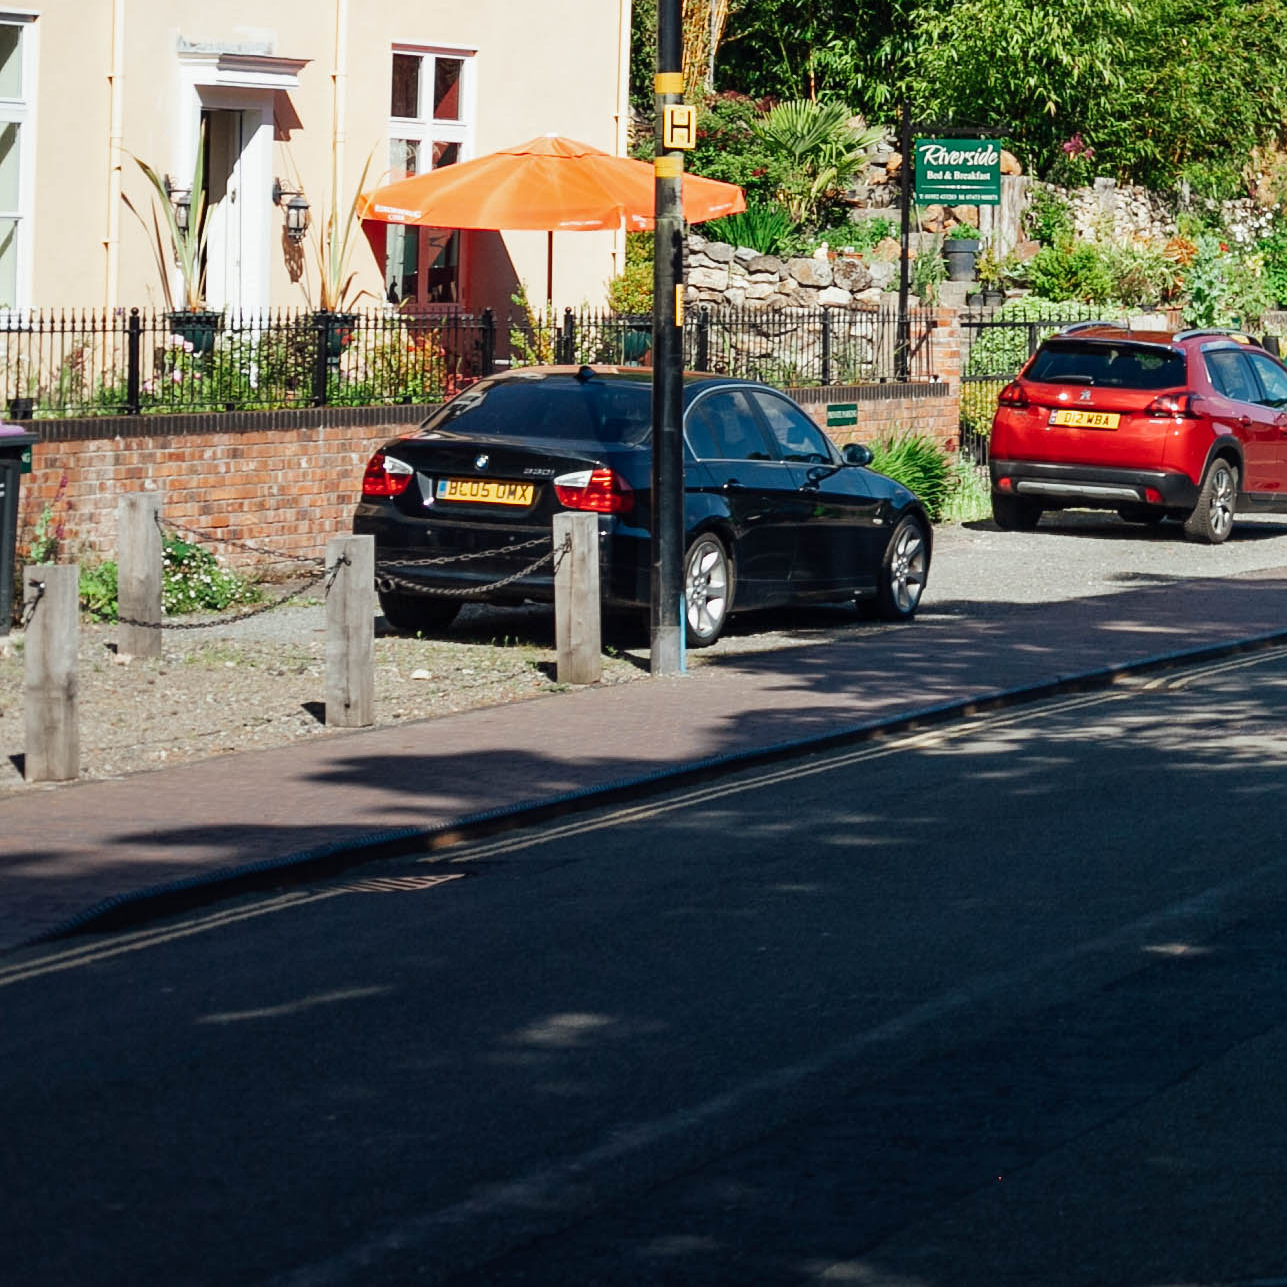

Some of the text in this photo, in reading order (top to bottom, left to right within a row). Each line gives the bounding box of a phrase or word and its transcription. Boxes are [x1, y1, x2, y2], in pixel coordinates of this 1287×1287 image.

[671, 109, 691, 144] H
[919, 144, 999, 166] Riverside
[927, 171, 990, 180] Bed & Breakfast
[1086, 415, 1109, 425] WBA
